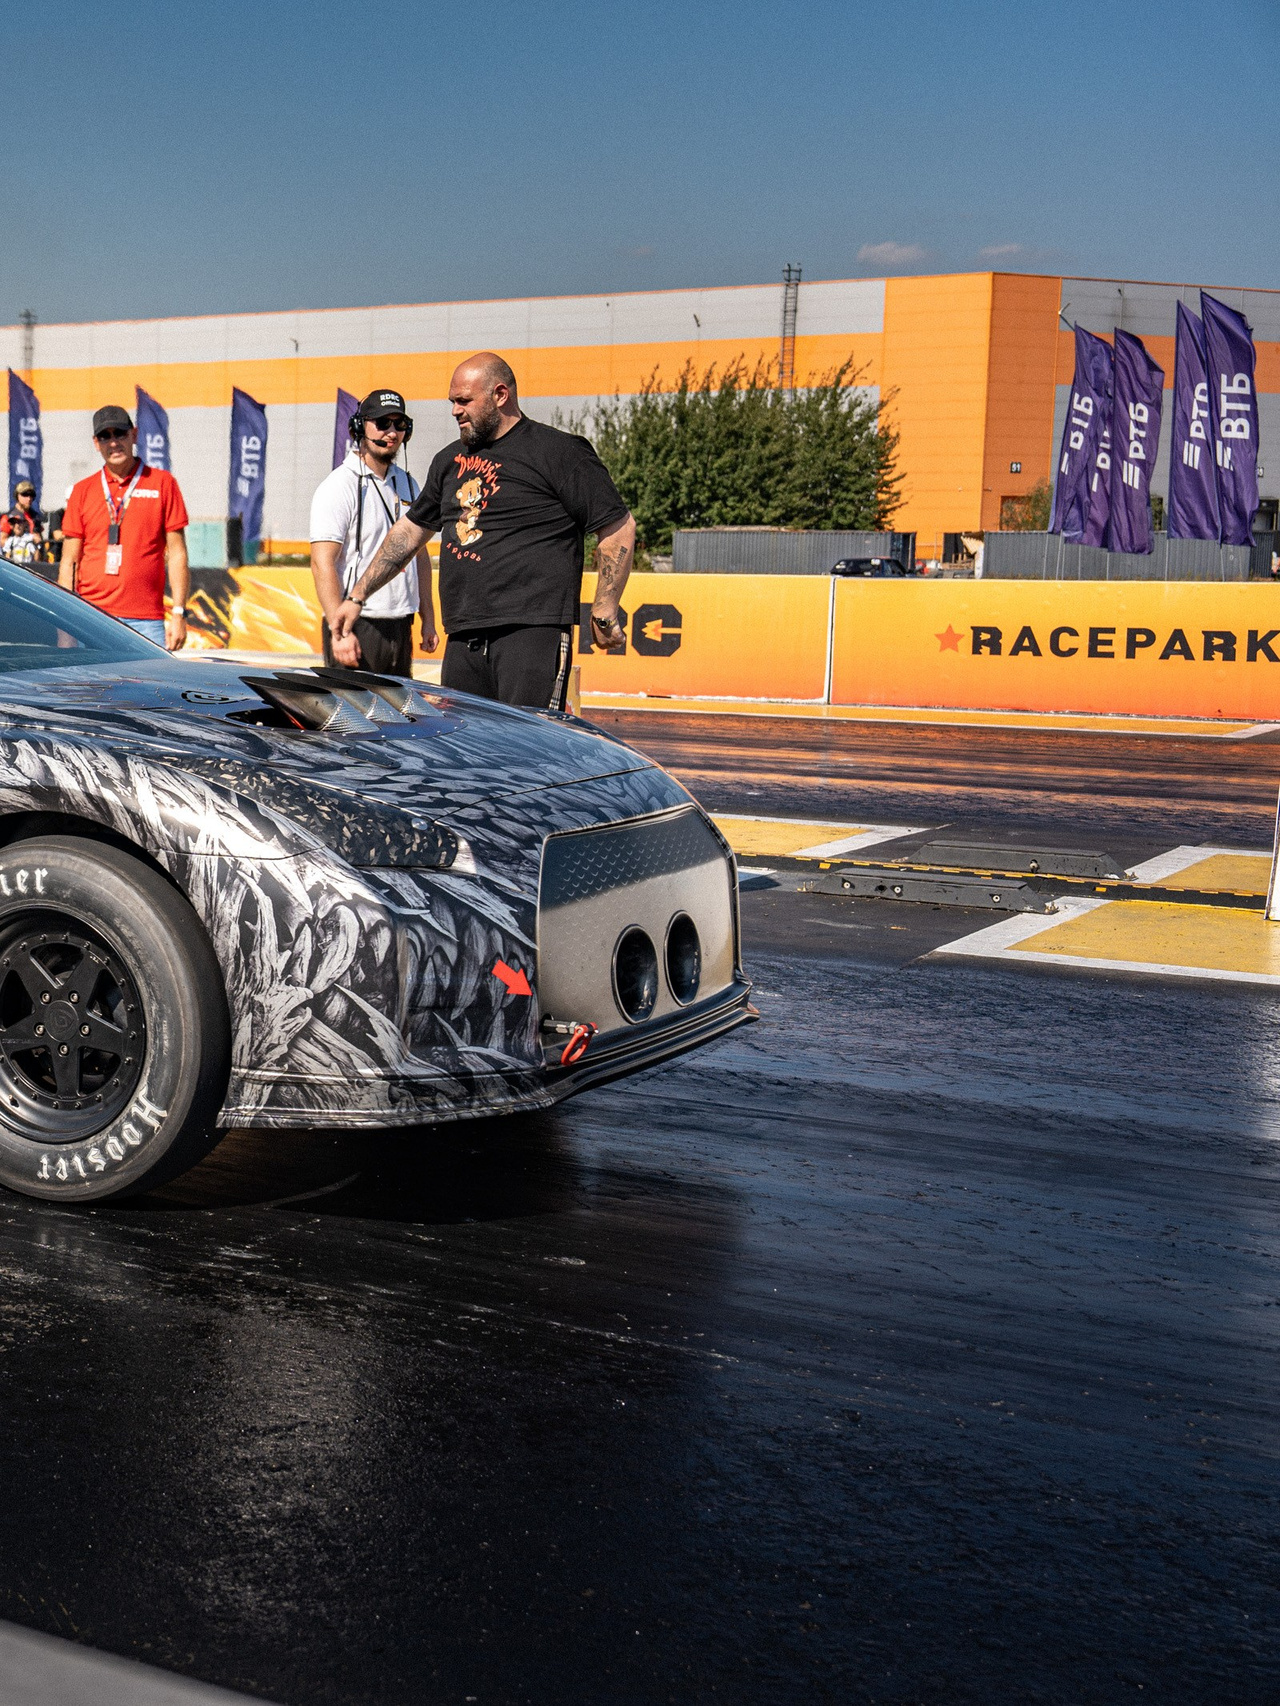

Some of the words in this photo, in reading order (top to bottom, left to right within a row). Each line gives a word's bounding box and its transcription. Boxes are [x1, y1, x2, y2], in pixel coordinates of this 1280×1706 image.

[380, 393, 400, 402] RDRC
[1220, 372, 1251, 440] ВТБ
[20, 418, 38, 459] ВТБ
[240, 435, 261, 479] ВТБ
[970, 625, 1280, 663] RACEPARK
[37, 1085, 168, 1181] Hoosier
